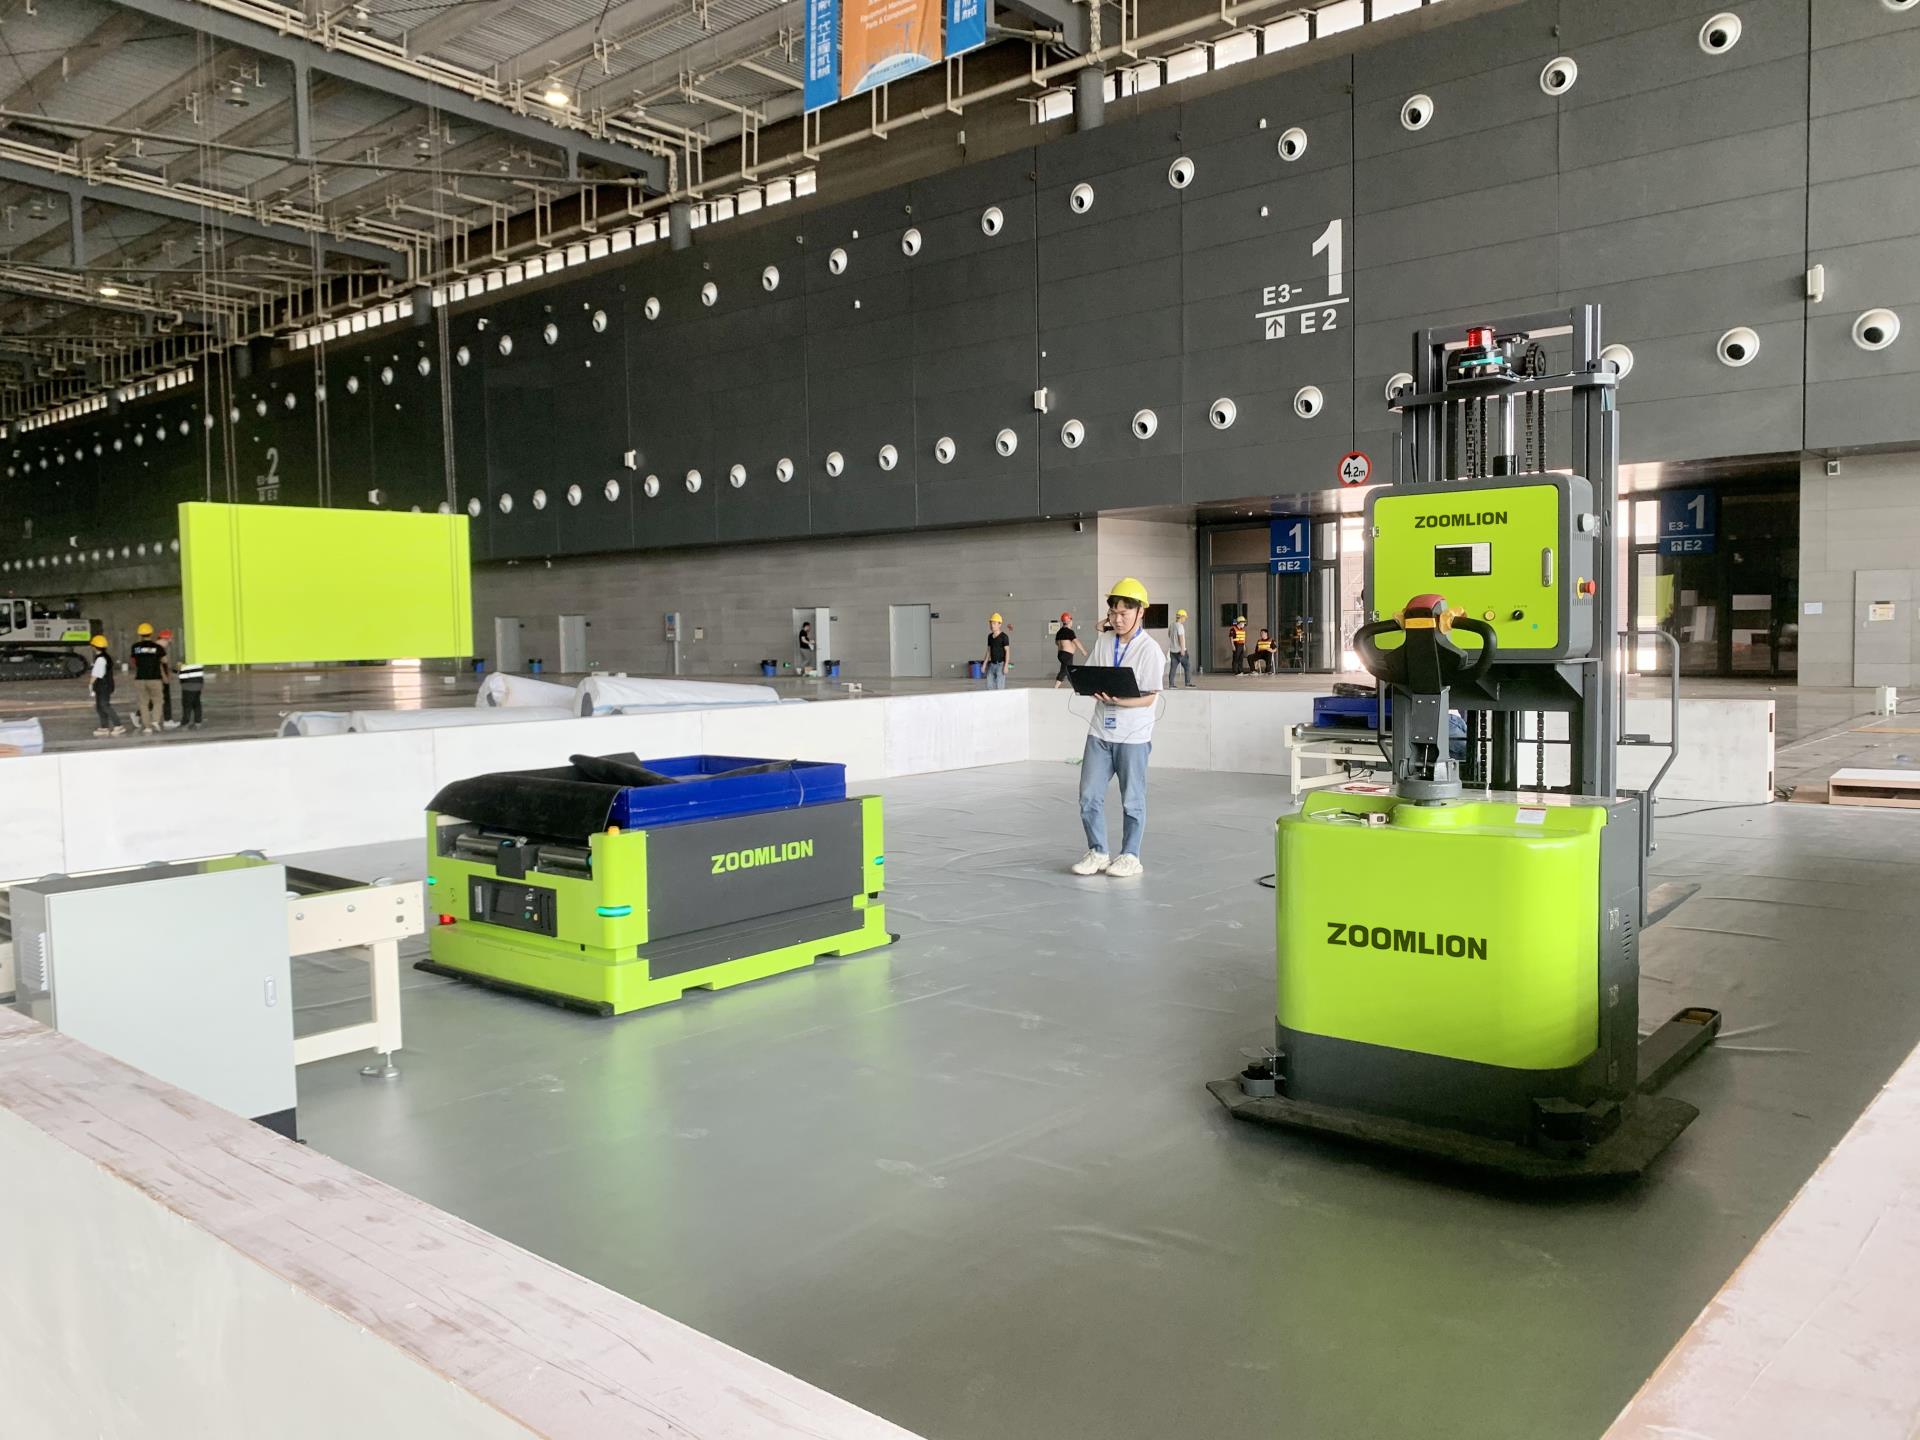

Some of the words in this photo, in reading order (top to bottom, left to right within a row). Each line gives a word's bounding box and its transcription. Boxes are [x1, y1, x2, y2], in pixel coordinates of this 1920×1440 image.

[1414, 511, 1508, 529] ZOOMLION
[1683, 539, 1703, 551] E2
[1286, 560, 1301, 571] E2
[711, 838, 814, 875] ZOOMLION
[1327, 921, 1488, 961] ZOOMLION
